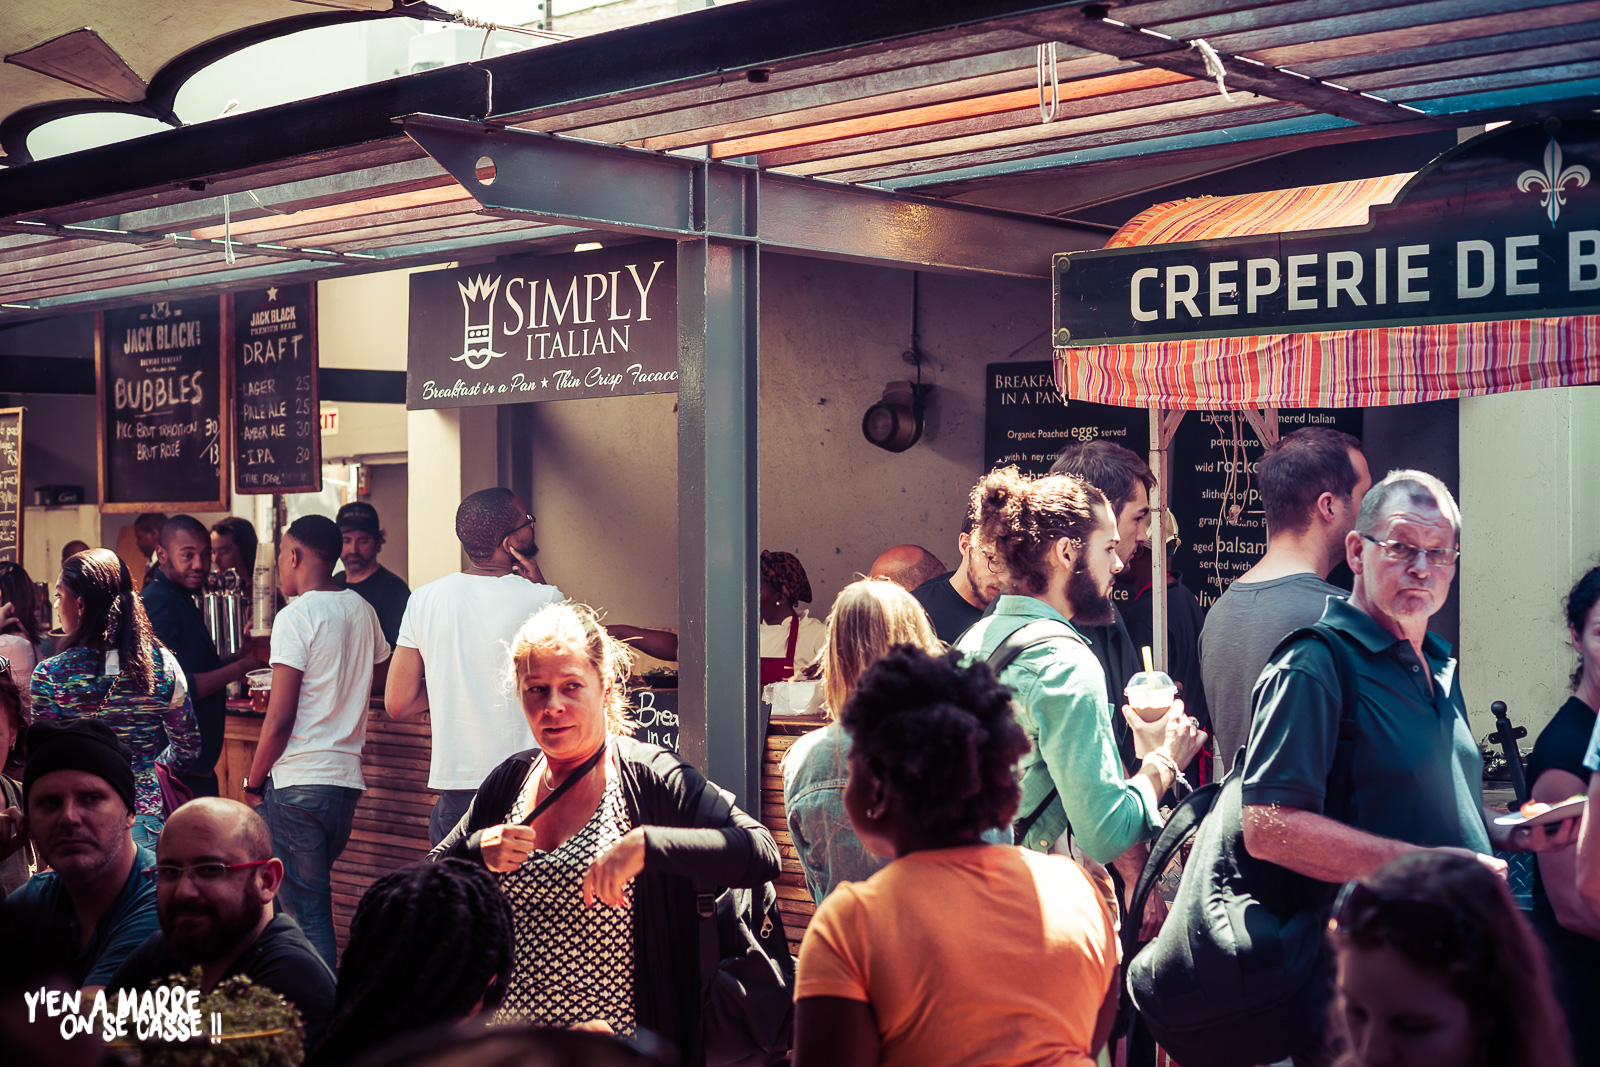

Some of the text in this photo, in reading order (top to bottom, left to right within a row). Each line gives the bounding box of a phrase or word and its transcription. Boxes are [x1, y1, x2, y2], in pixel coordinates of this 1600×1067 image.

[1130, 229, 1600, 322] CREPERIE DE B
[503, 260, 665, 336] SIMPLY
[250, 305, 296, 327] JACK BLACK
[123, 328, 154, 355] JACK
[243, 334, 304, 366] DRAFT
[525, 325, 632, 361] ITALIAN
[114, 371, 203, 412] BUBBLES
[243, 375, 310, 397] LAGER 25
[422, 363, 678, 400] Breakfast in a Pan Thin Crisp Facacc
[995, 375, 1055, 389] BREAKFA
[1001, 391, 1062, 405] IN A PAN
[243, 398, 310, 421] PALE ALE 25
[1308, 413, 1336, 424] Italian
[136, 422, 156, 438] BRUT
[159, 421, 198, 438] TRADITION
[205, 418, 219, 437] 30
[271, 423, 287, 438] ALE
[296, 421, 311, 438] 30
[1007, 426, 1127, 441] Organic Poached eggs served
[137, 443, 158, 461] BRUT
[210, 443, 220, 465] 13
[296, 446, 311, 464] 30
[1047, 452, 1060, 461] cris
[1195, 461, 1214, 473] wild
[1193, 535, 1268, 555] aged balsam
[1199, 560, 1252, 572] served with
[635, 691, 679, 728] Brea
